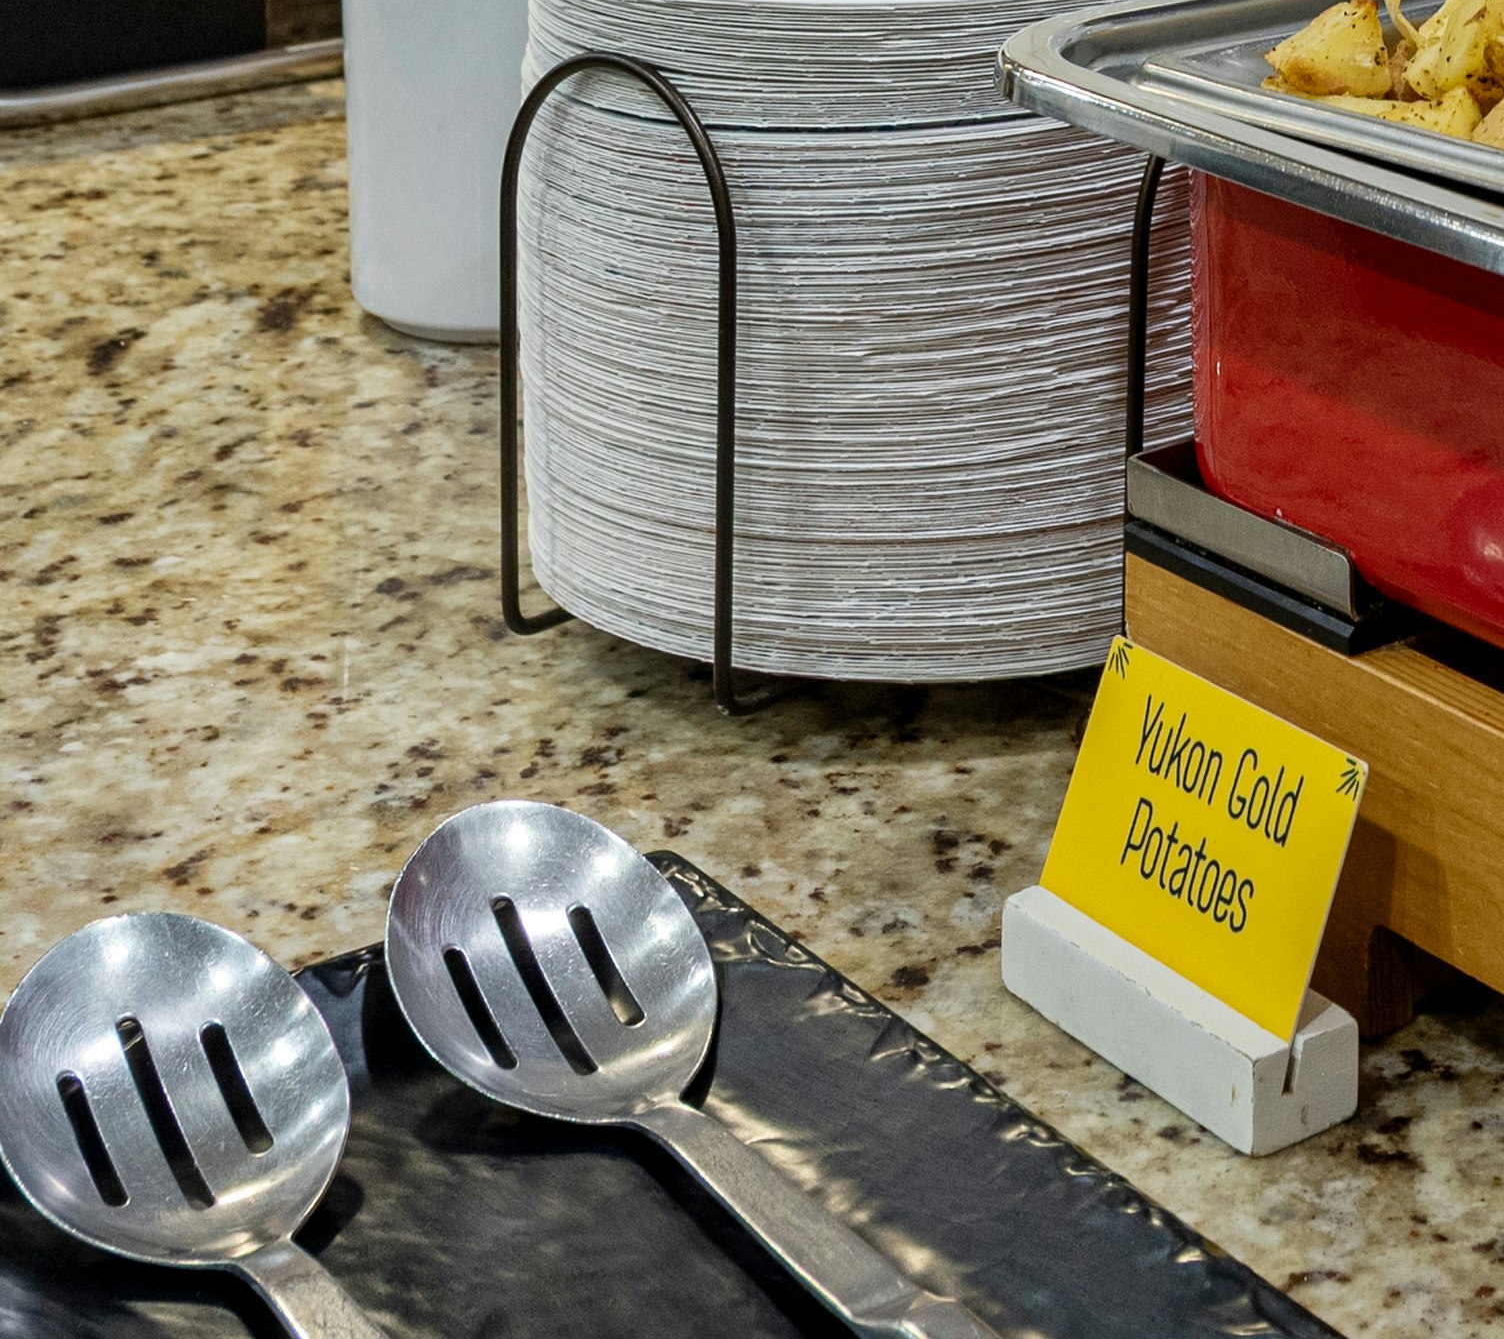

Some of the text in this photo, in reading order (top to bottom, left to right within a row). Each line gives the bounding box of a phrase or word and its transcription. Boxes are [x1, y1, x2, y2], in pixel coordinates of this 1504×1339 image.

[1133, 694, 1305, 848] Yukon Gold
[1119, 797, 1255, 934] Potatoes
